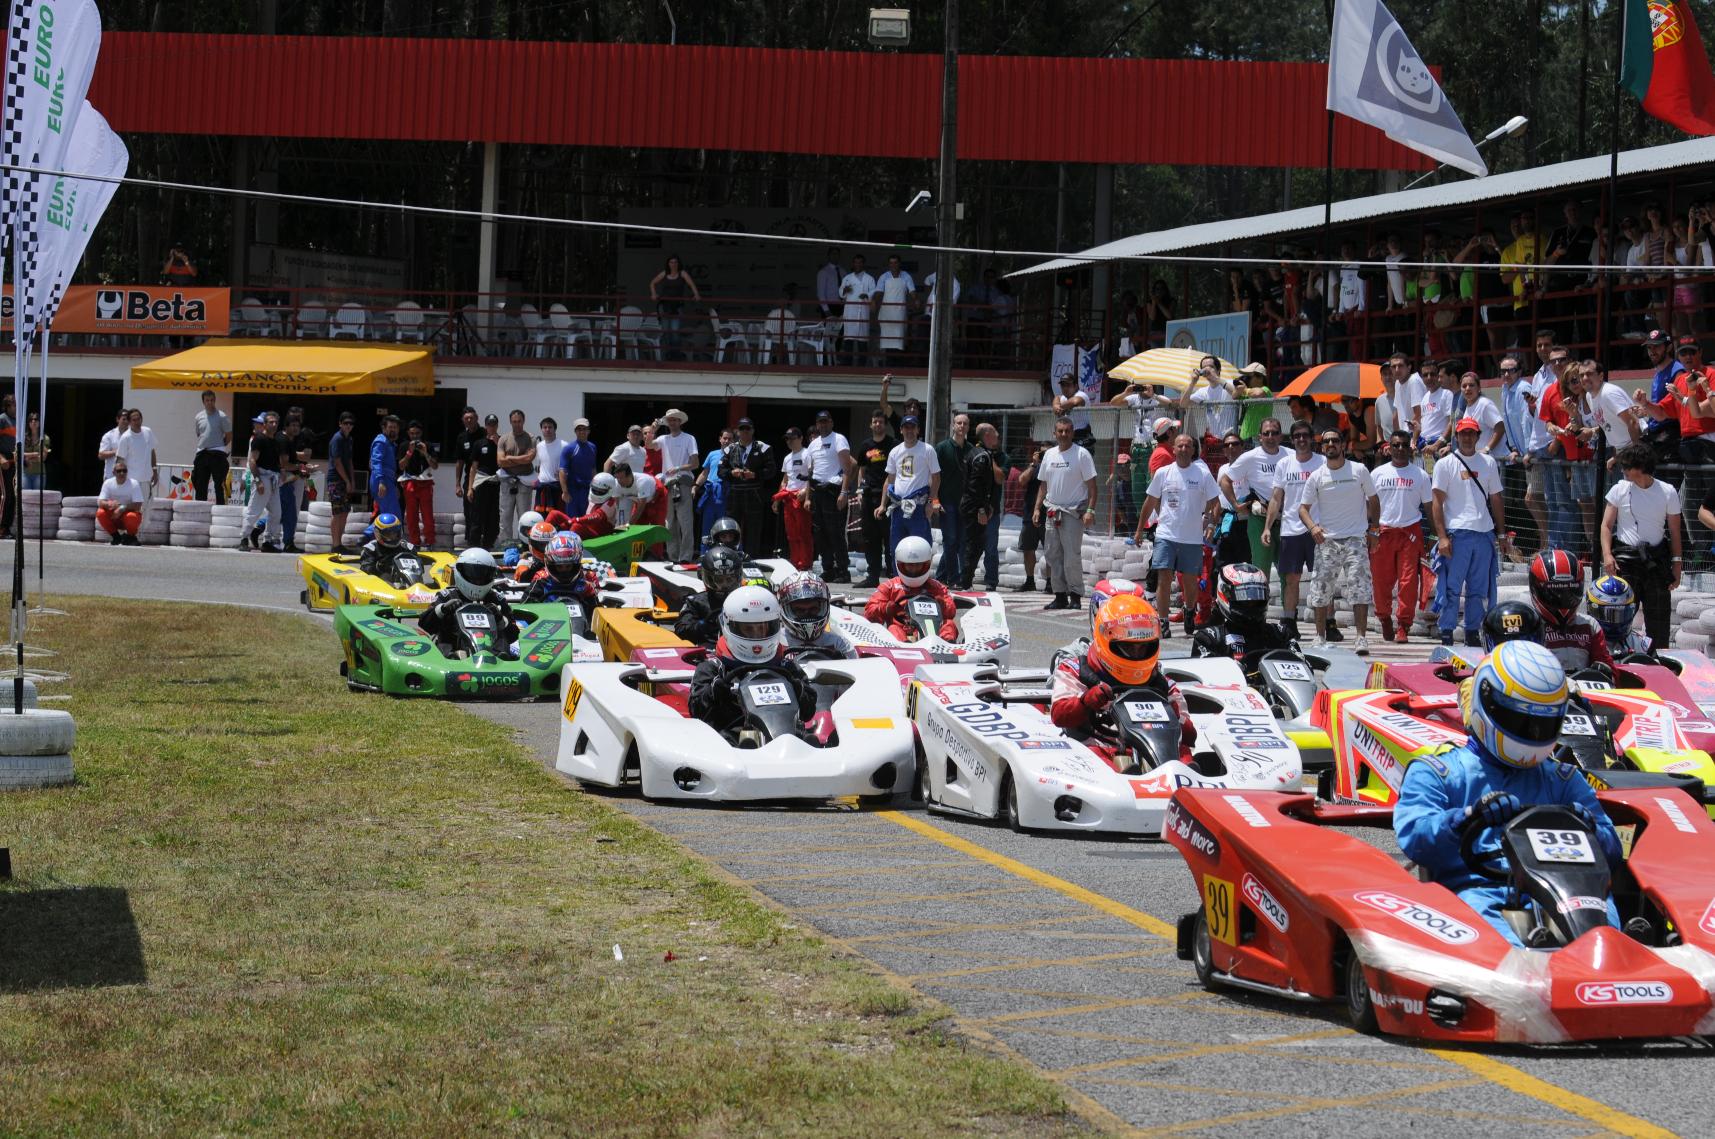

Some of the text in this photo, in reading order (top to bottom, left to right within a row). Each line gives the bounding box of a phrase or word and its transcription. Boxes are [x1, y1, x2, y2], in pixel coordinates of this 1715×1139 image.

[33, 4, 54, 90] EURO
[127, 291, 207, 322] Beta
[171, 381, 339, 393] www.pestronix.pt
[1381, 477, 1414, 487] UNITRIP
[1504, 616, 1521, 627] tvi
[481, 676, 520, 686] JOGOS
[756, 685, 781, 694] 129
[907, 682, 918, 720] 90
[945, 728, 975, 770] Desportivo
[974, 763, 987, 783] BPI
[1354, 721, 1395, 770] UNITRIP
[1177, 819, 1193, 839] and
[1536, 831, 1582, 846] 39
[1208, 882, 1230, 939] 39
